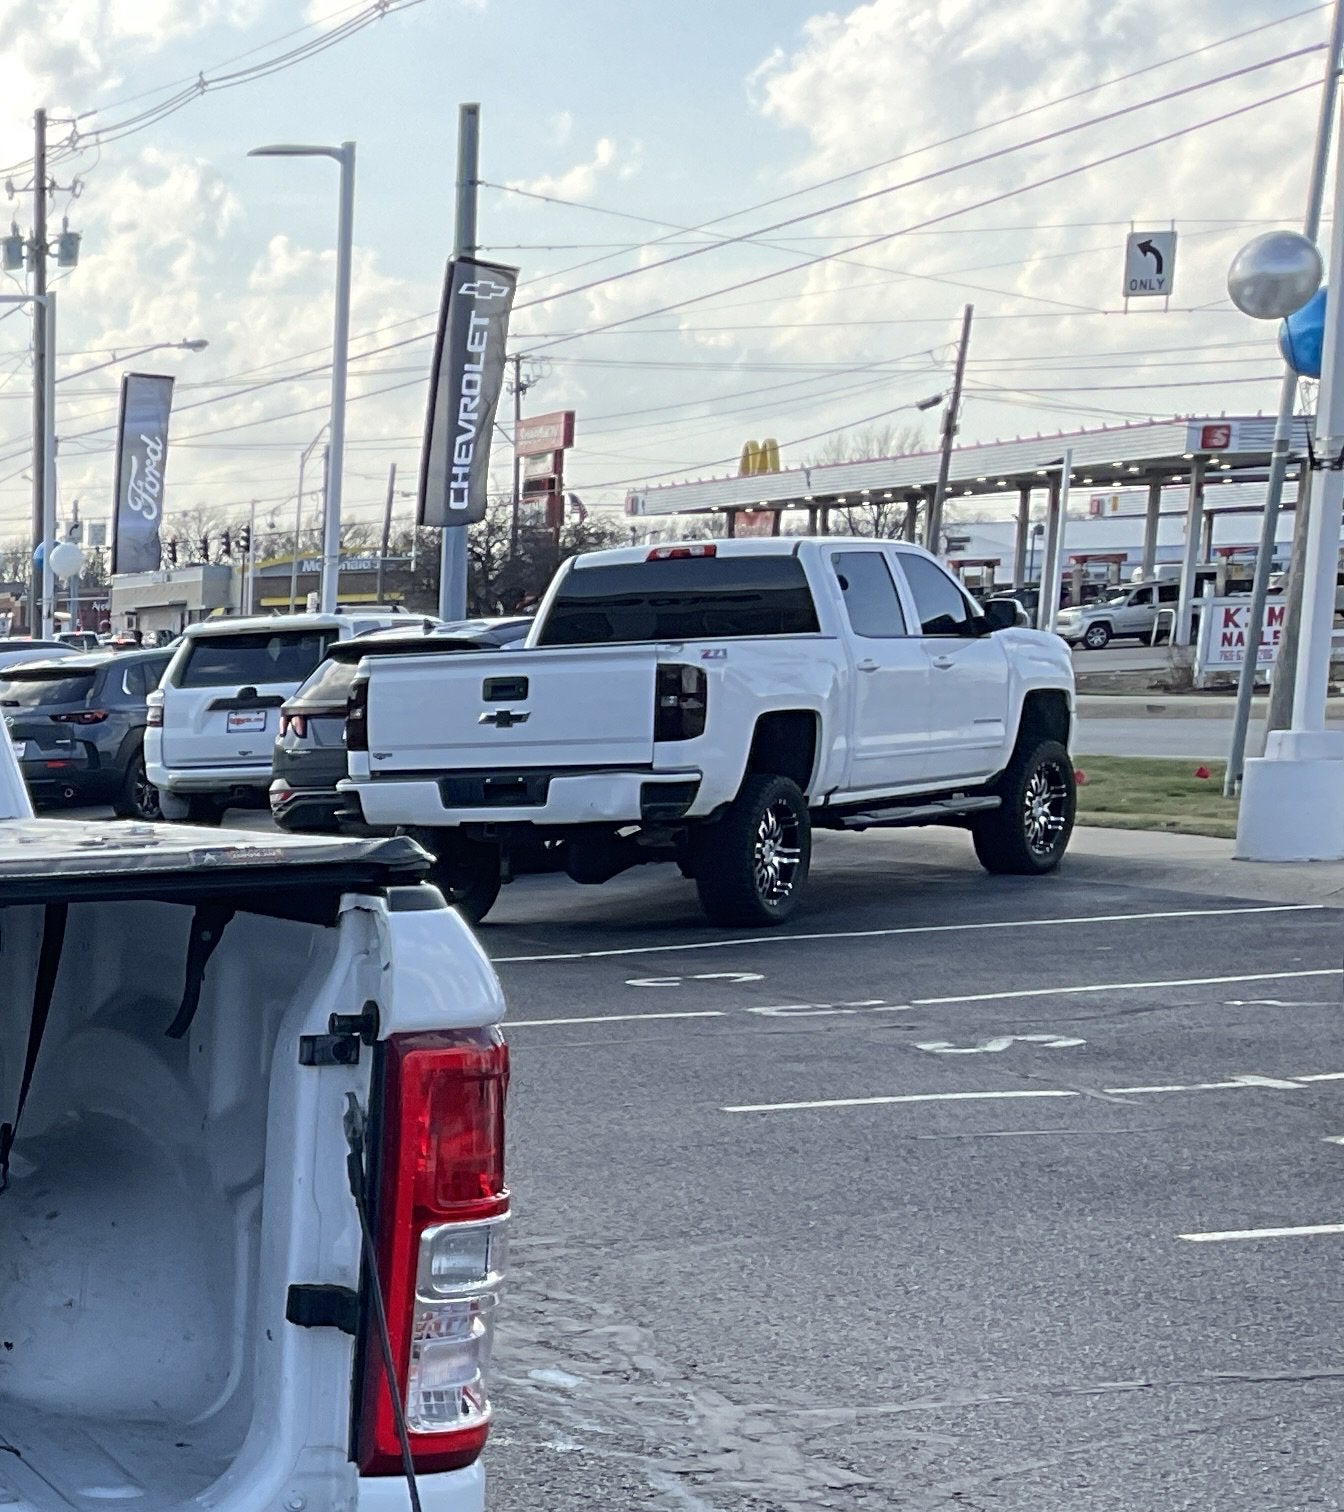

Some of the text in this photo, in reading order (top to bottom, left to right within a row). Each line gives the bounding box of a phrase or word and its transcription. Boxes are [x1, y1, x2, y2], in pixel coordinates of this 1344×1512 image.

[1129, 278, 1165, 292] ONLY
[448, 310, 490, 511] CHEVROLET
[127, 434, 164, 521] Ford
